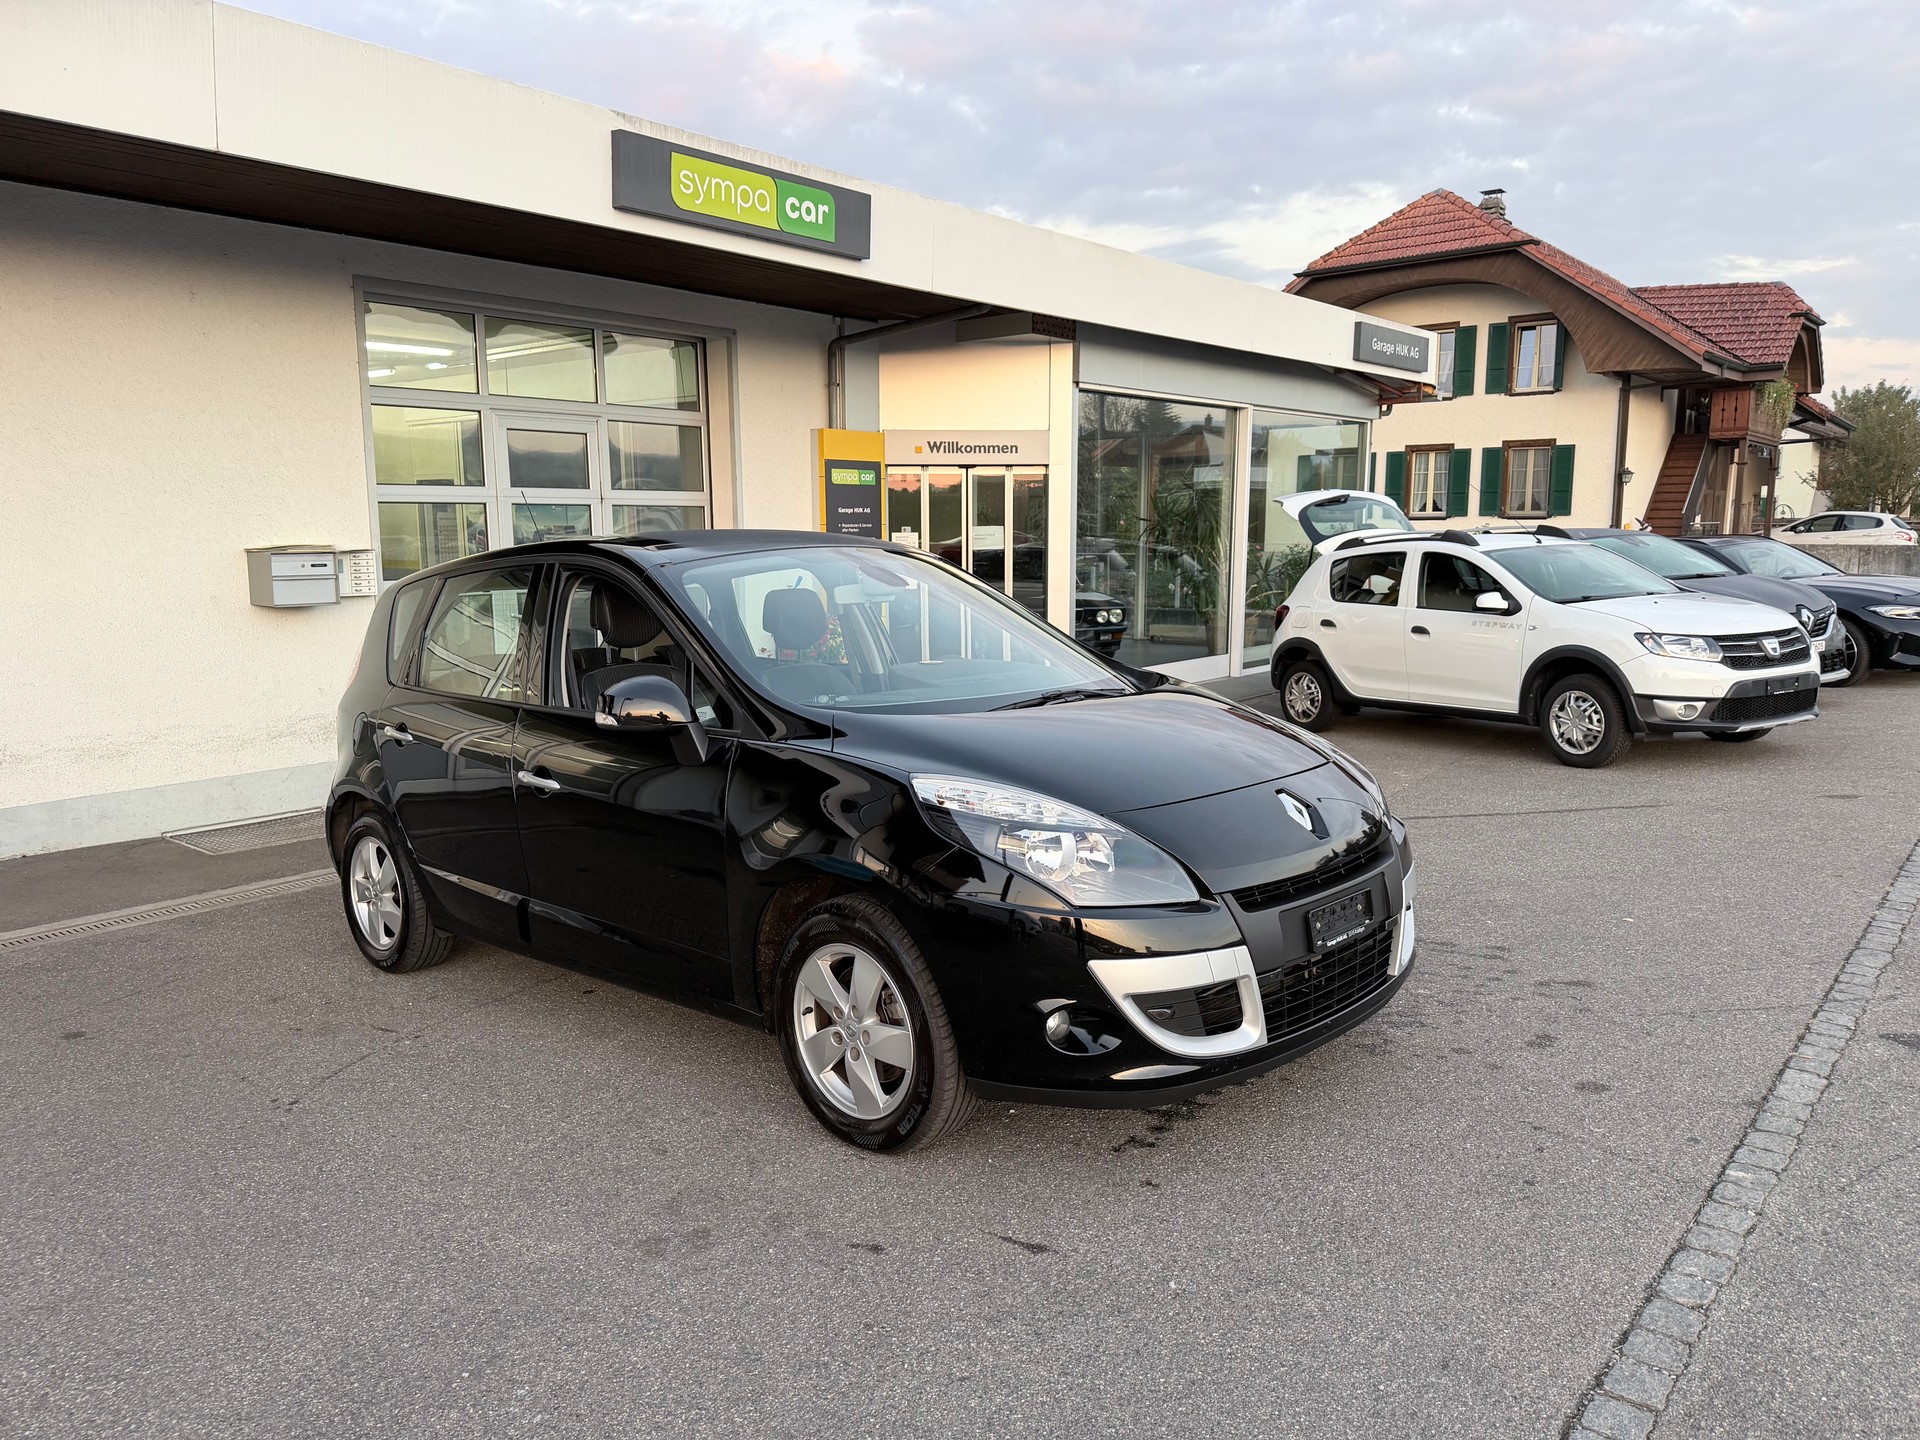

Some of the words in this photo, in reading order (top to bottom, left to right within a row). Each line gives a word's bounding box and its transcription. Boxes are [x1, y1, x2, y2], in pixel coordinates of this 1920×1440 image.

[679, 169, 771, 214] sympa
[785, 196, 829, 225] car
[1372, 337, 1395, 355] Garage
[1396, 342, 1409, 357] HUK
[1410, 346, 1419, 359] AG
[927, 441, 1019, 453] Willkommen
[833, 471, 858, 483] sympa
[860, 473, 874, 482] car
[1471, 621, 1522, 629] STEPWAY
[896, 1103, 923, 1135] TECAR
